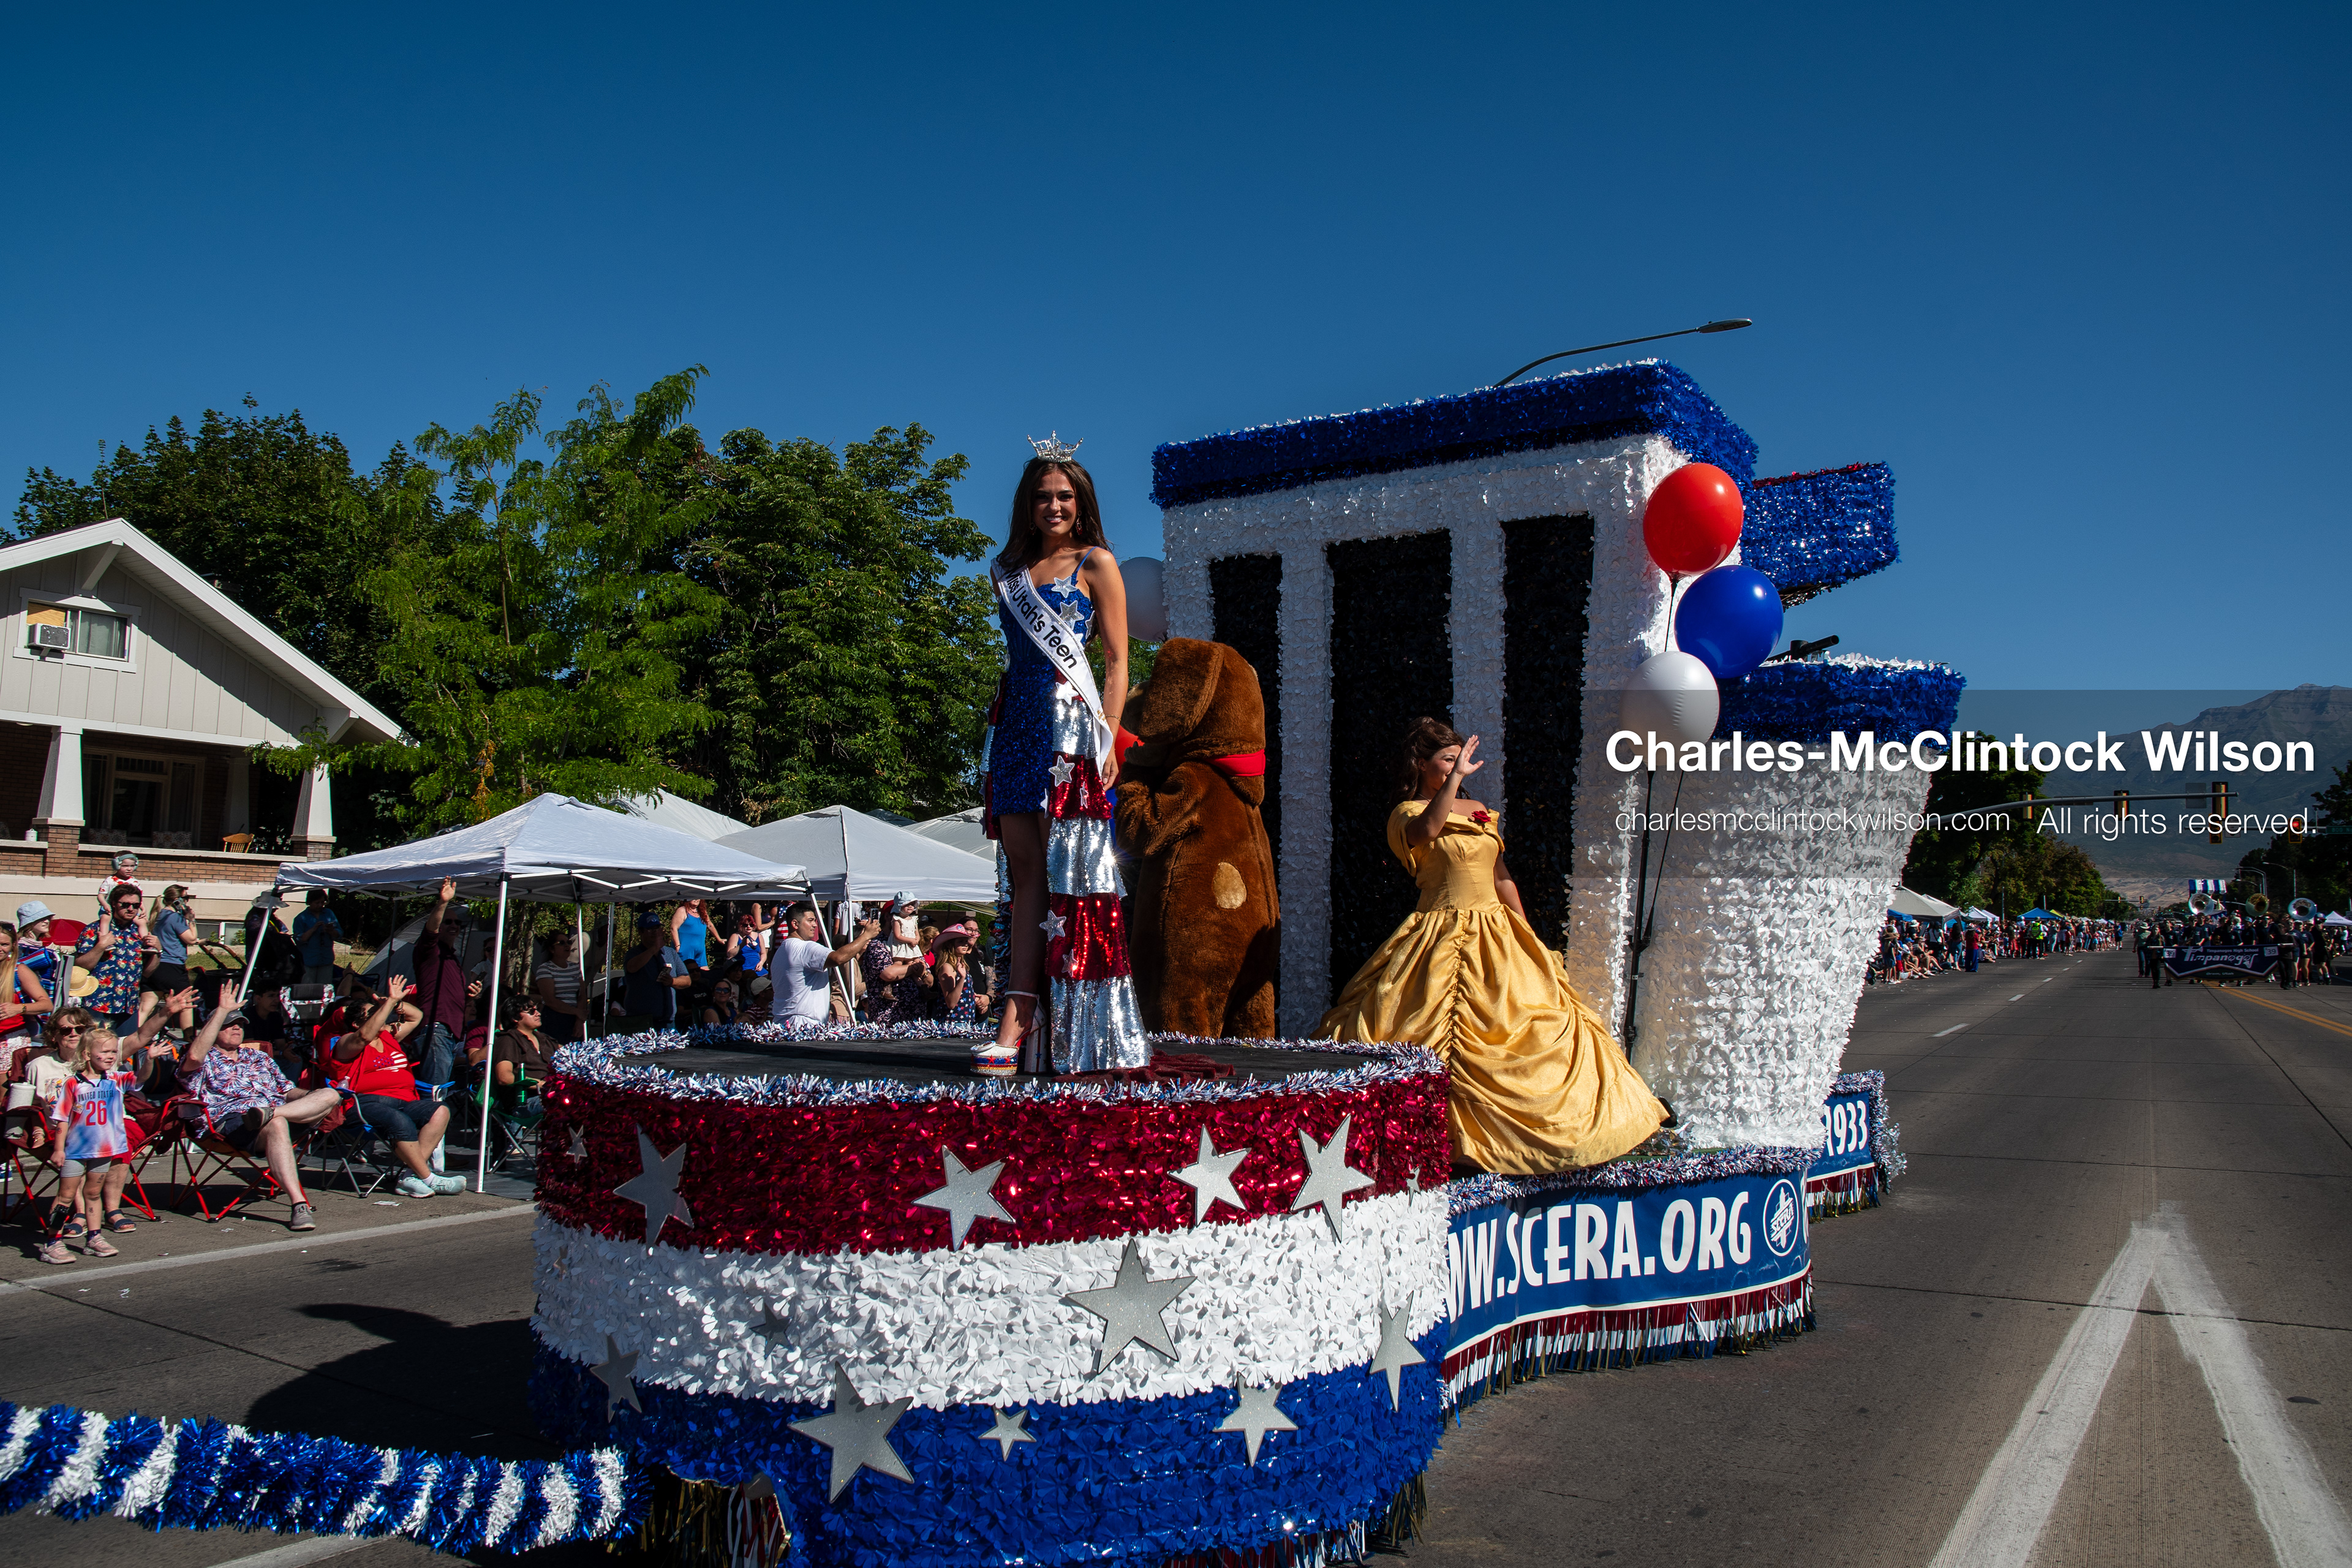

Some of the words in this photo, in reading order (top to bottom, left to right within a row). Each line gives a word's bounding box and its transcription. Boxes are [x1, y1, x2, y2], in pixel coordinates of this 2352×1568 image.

[1012, 585, 1046, 633] Utah's
[1042, 625, 1077, 669] Teen
[78, 1091, 96, 1102] UNITED
[86, 1099, 107, 1126] 26
[1824, 1099, 1868, 1157] 1933
